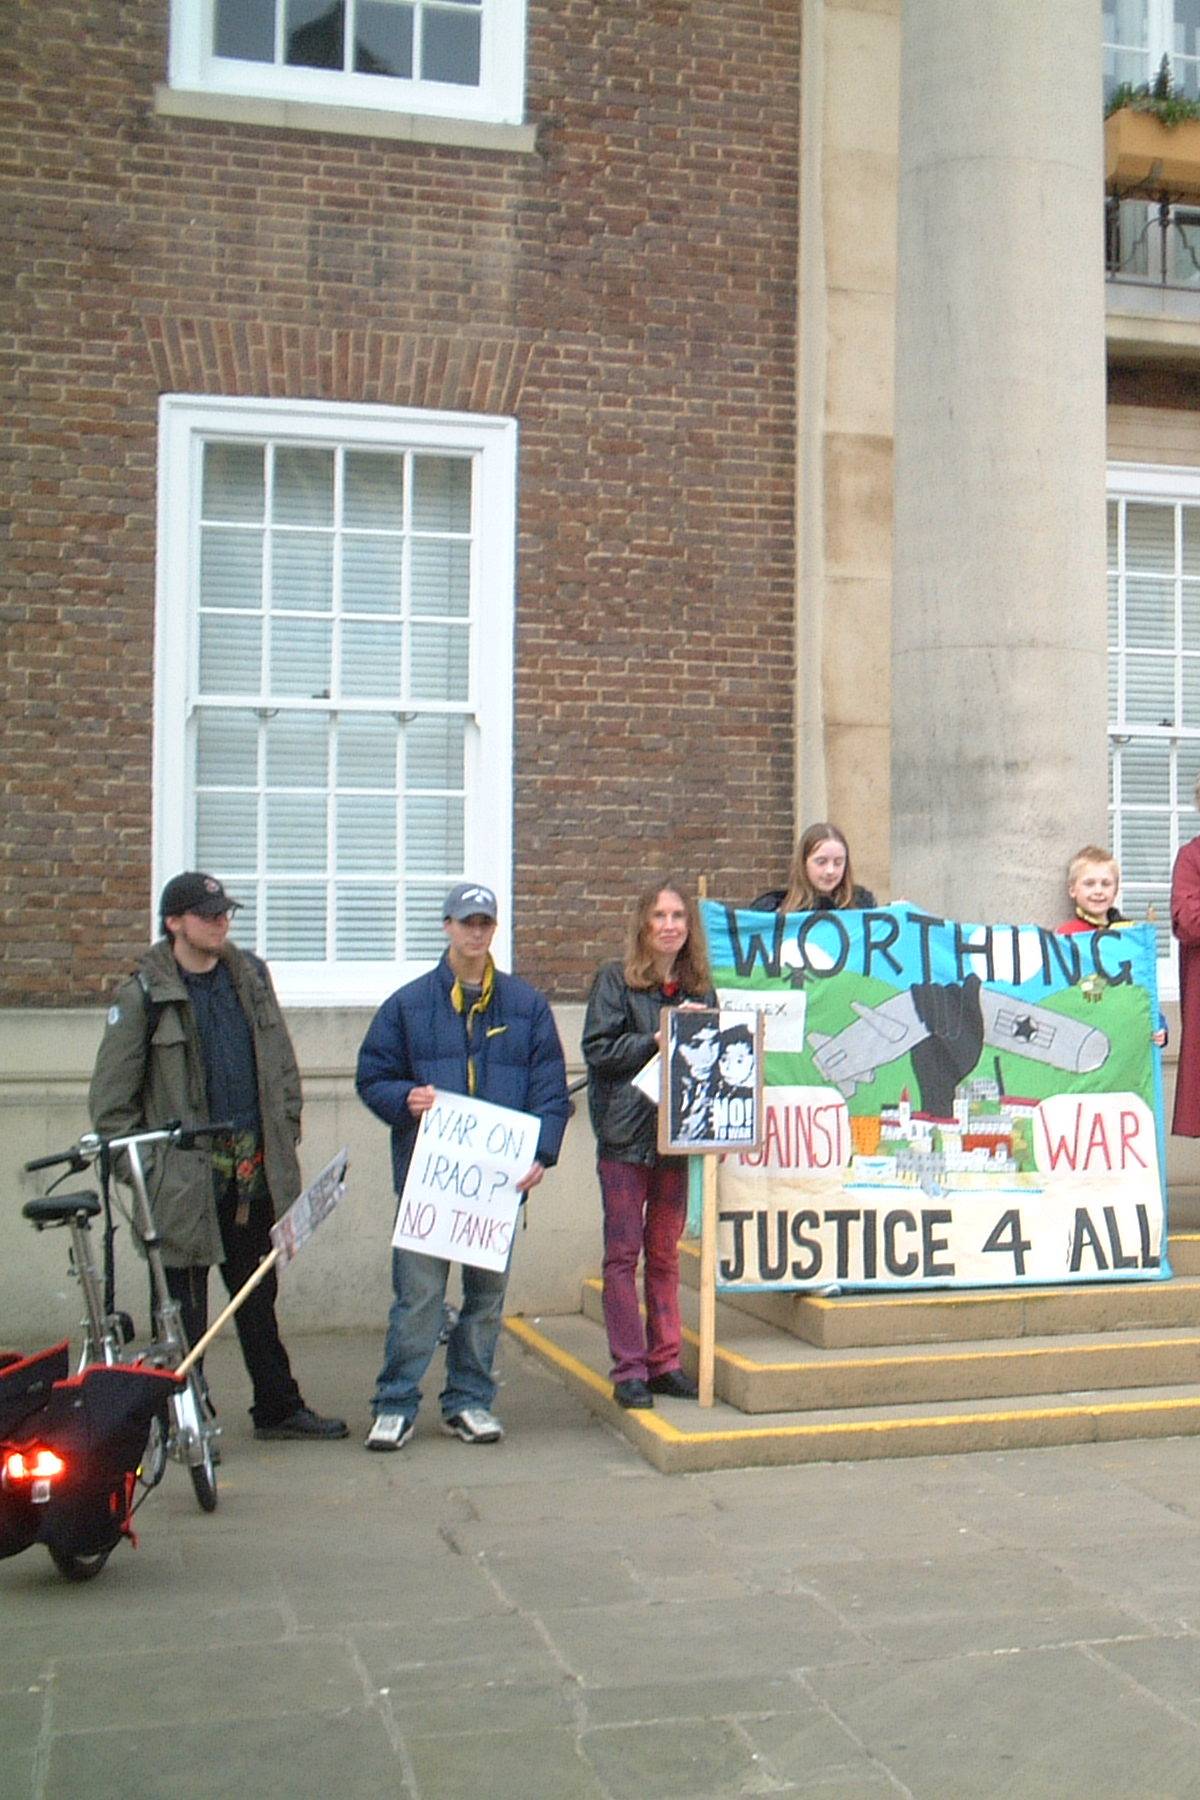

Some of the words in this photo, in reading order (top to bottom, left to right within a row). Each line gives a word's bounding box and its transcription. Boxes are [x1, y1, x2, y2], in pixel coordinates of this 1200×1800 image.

[726, 907, 1134, 986] WORTHING
[423, 1106, 478, 1148] WAR
[486, 1122, 525, 1159] ON
[713, 1097, 753, 1127] NO!
[718, 1103, 847, 1169] AINST
[1033, 1102, 1149, 1172] WAR
[401, 1200, 437, 1239] NO
[450, 1208, 512, 1256] TANKS
[719, 1208, 955, 1281] JUSTICE
[981, 1209, 1032, 1276] 4
[1068, 1203, 1161, 1272] ALL
